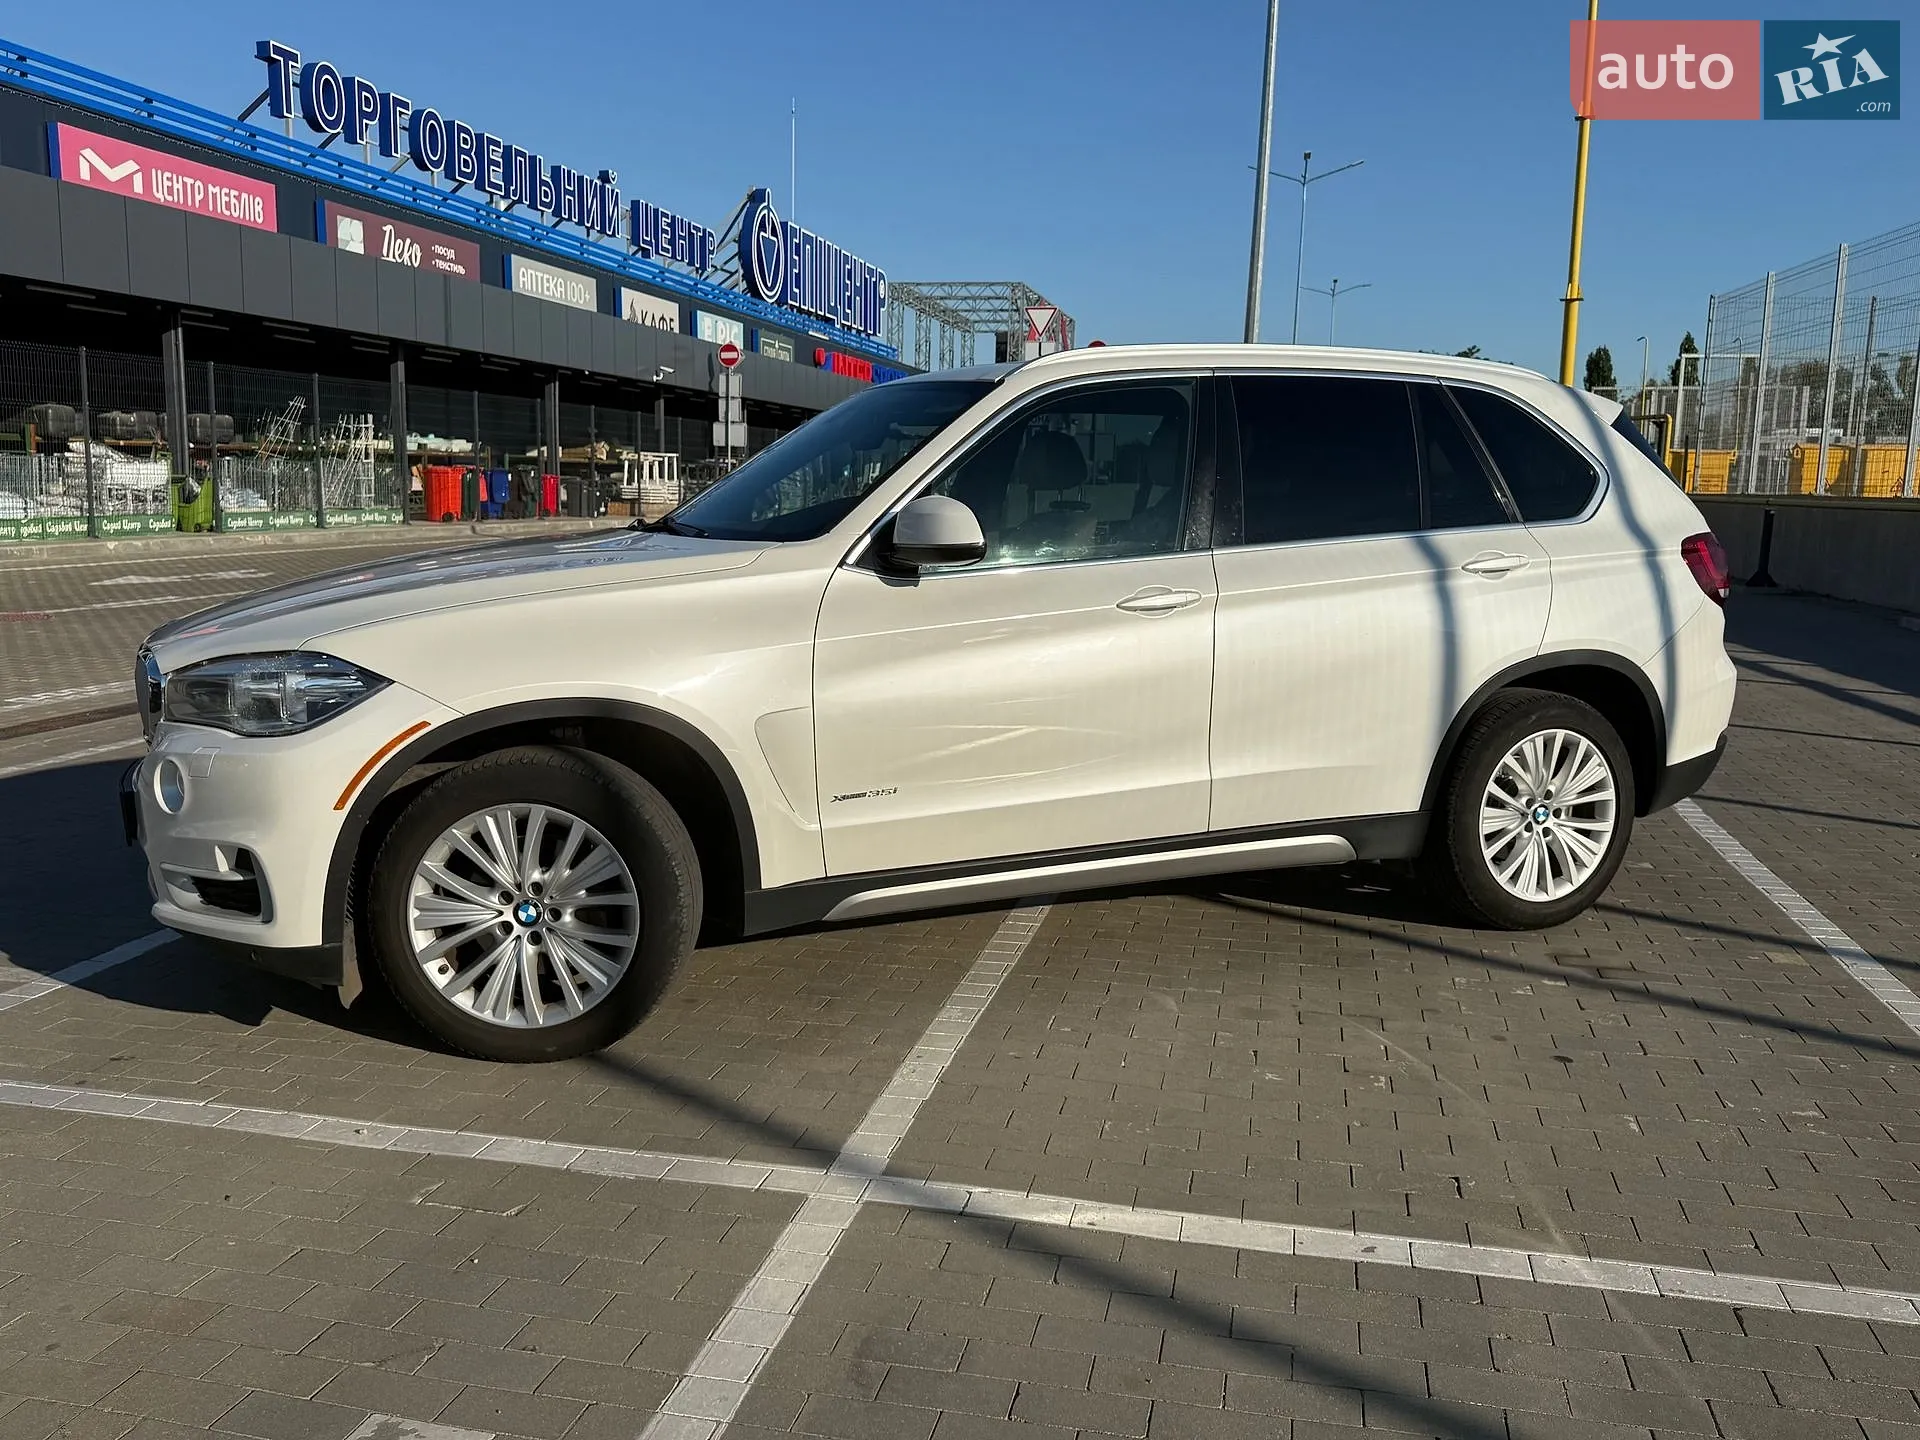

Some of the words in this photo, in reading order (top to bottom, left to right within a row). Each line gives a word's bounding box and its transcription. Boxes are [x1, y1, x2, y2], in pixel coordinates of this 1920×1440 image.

[151, 168, 204, 208] ЦЕНТР
[208, 184, 264, 224] МЕБЛІВ
[256, 40, 621, 239] ТОРГОВЕЛЬНИЙ
[631, 200, 717, 272] ЦЕНТР
[519, 267, 565, 299] АПТЕКА
[567, 279, 590, 305] 100+
[781, 221, 888, 337] ЕПІЦЕНТР
